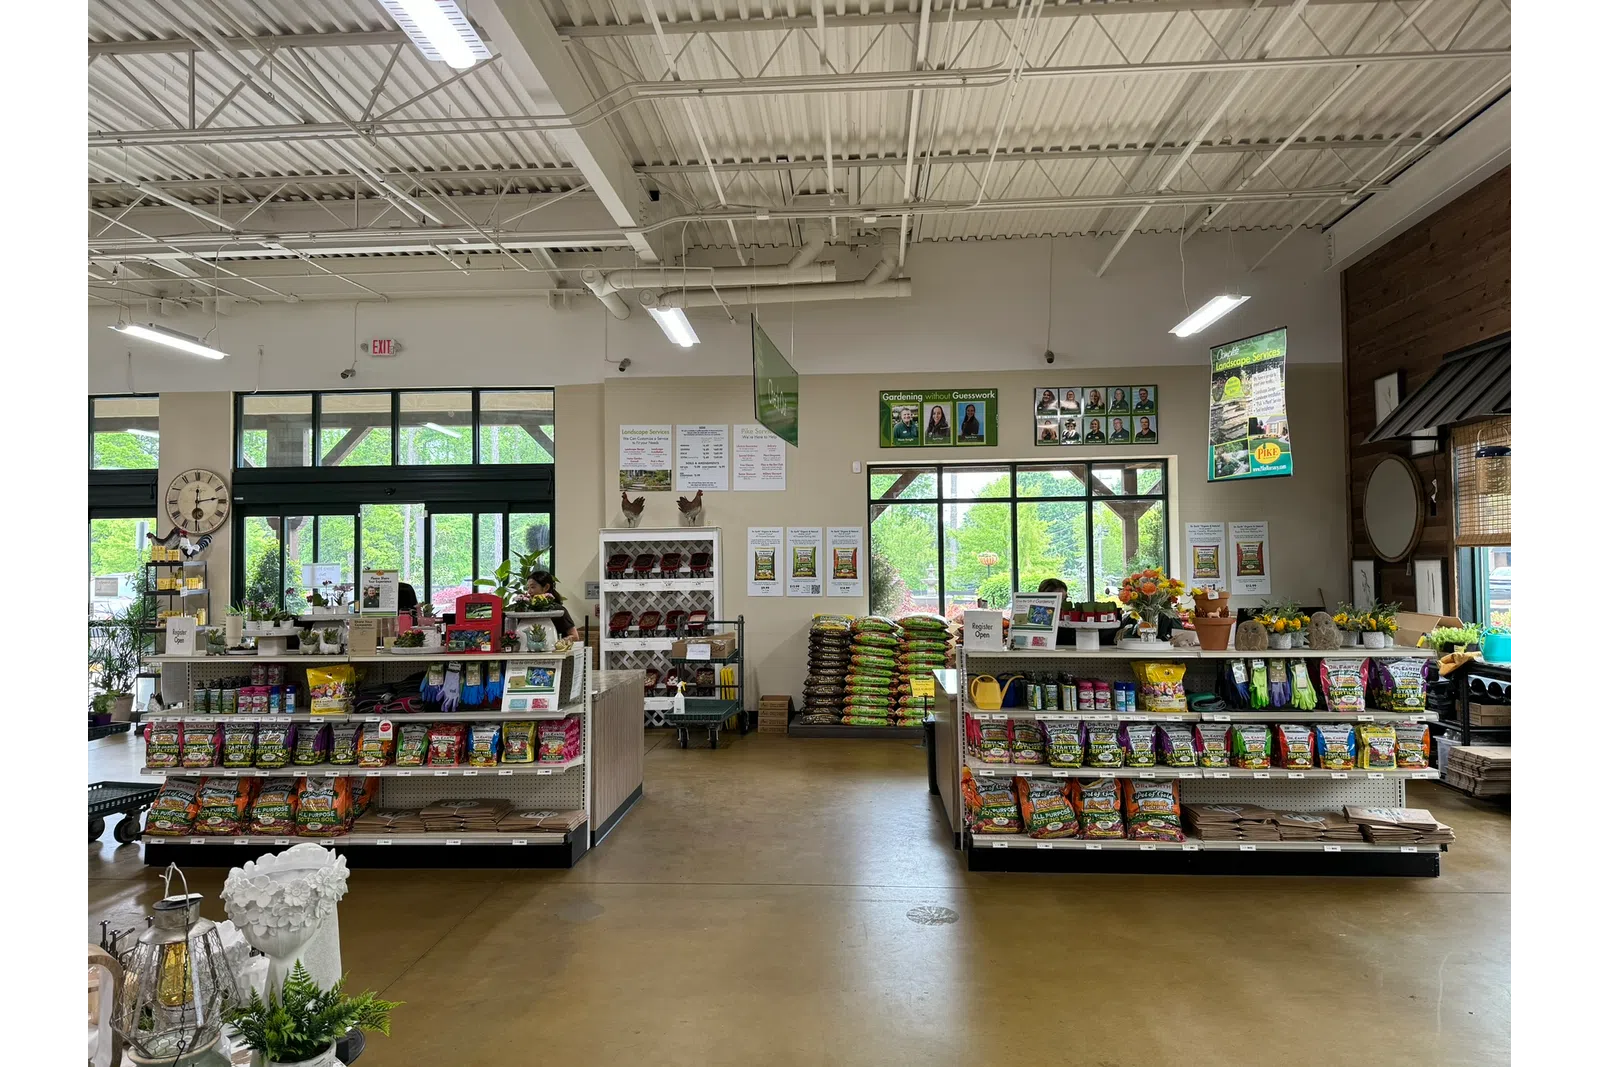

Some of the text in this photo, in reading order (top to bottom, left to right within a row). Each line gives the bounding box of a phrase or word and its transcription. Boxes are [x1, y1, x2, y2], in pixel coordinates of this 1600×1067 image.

[372, 340, 392, 354] EXIT
[1216, 348, 1280, 370] Landscape Services
[882, 392, 923, 402] Gardening
[952, 390, 996, 400] Guesswork
[1258, 448, 1278, 460] PIKE
[972, 622, 993, 631] Register
[975, 631, 990, 639] Open
[1045, 809, 1070, 818] PURPOSE
[1034, 817, 1059, 825] POTTING
